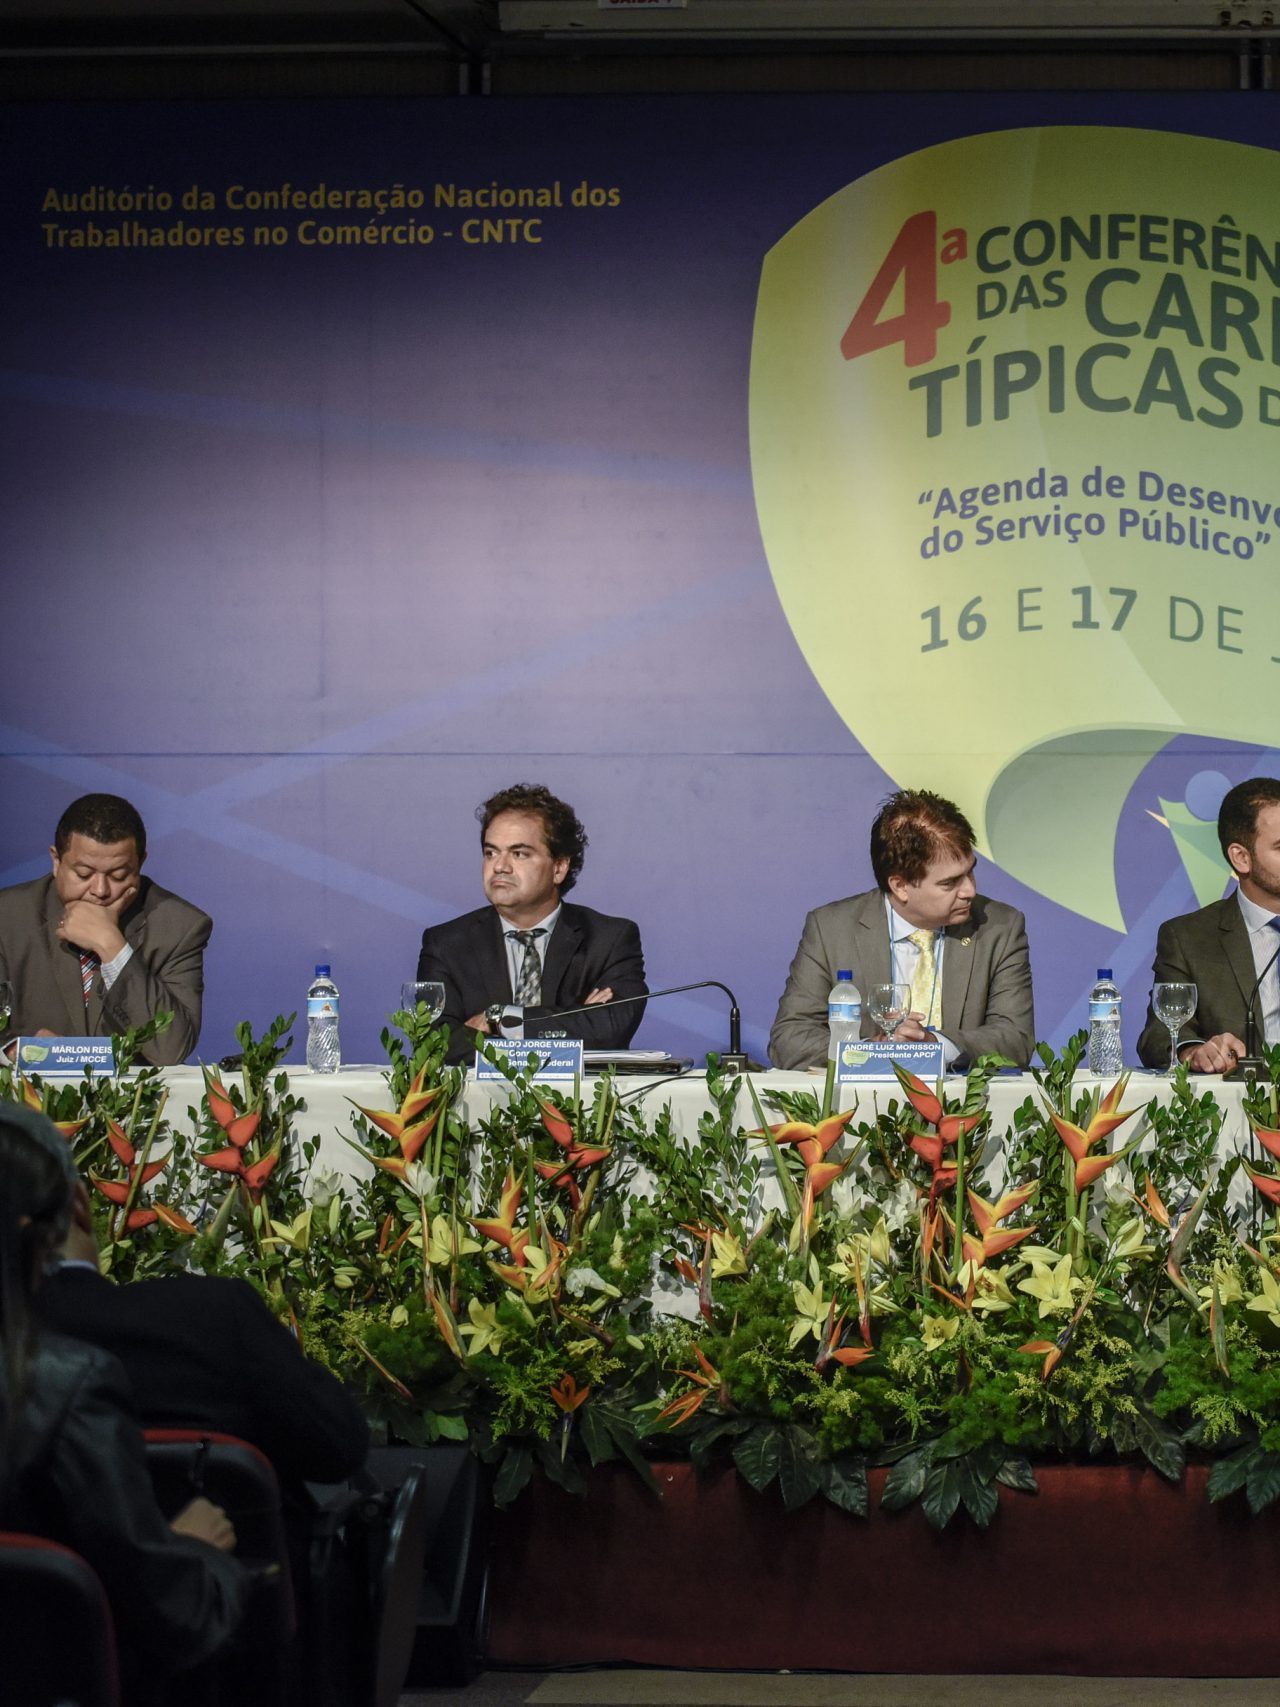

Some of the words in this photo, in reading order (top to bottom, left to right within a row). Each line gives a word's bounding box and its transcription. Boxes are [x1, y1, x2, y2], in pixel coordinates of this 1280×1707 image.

[42, 185, 173, 212] Auditório
[182, 185, 216, 211] da
[226, 182, 425, 214] Confederação
[434, 181, 560, 209] Nacional
[571, 181, 621, 207] dos
[42, 221, 244, 249] Trabalhadores
[254, 228, 287, 246] no
[298, 217, 434, 246] Comércio
[461, 218, 544, 244] CNTC
[977, 270, 1068, 321] DAS
[908, 335, 1244, 439] TÍPICAS
[1081, 465, 1126, 499] de
[920, 525, 964, 560] do
[974, 503, 1106, 544] Serviço
[920, 595, 988, 654] 16
[1017, 586, 1044, 633] E
[1071, 584, 1138, 632] 17
[1169, 594, 1244, 655] DE
[56, 1055, 74, 1063] Juiz
[80, 1055, 108, 1063] MCCE
[92, 1046, 113, 1054] REIS
[484, 1040, 522, 1049] ONALDO
[522, 1040, 552, 1049] JORGE
[553, 1040, 581, 1049] VIEIRA
[844, 1043, 875, 1051] ANDRÉ
[896, 1043, 942, 1051] MORISSON
[869, 1051, 912, 1059] Presidente
[913, 1051, 937, 1059] APCF
